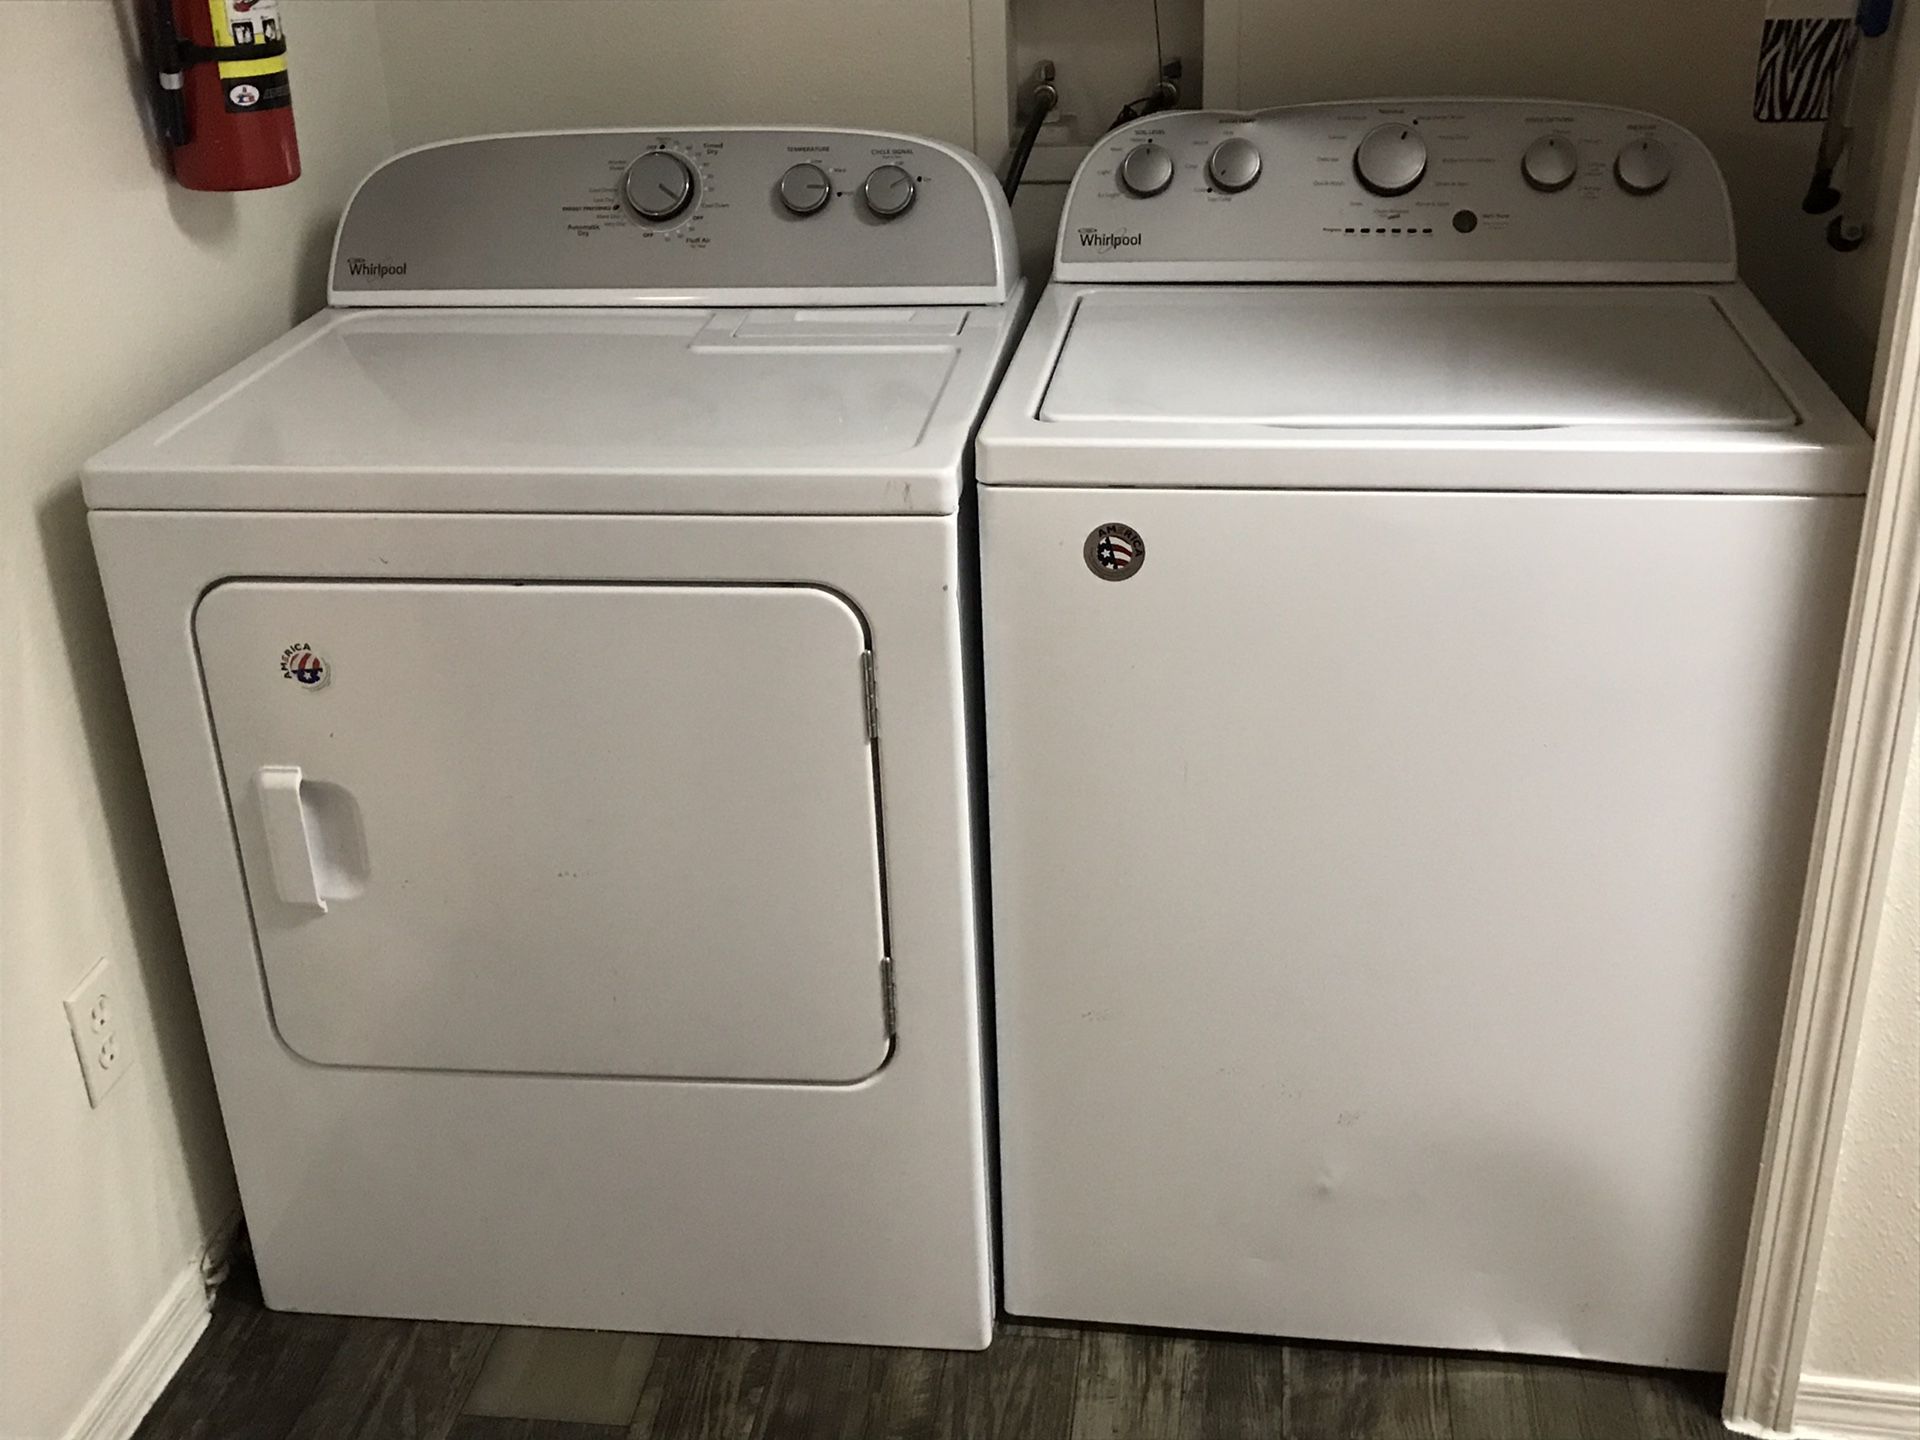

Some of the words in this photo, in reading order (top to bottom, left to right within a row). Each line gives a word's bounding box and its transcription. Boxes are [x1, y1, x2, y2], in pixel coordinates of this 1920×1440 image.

[567, 224, 601, 232] Automatic
[1080, 233, 1142, 250] Whirlpool
[349, 262, 407, 279] Whirlpool
[280, 642, 312, 679] AMERICA
